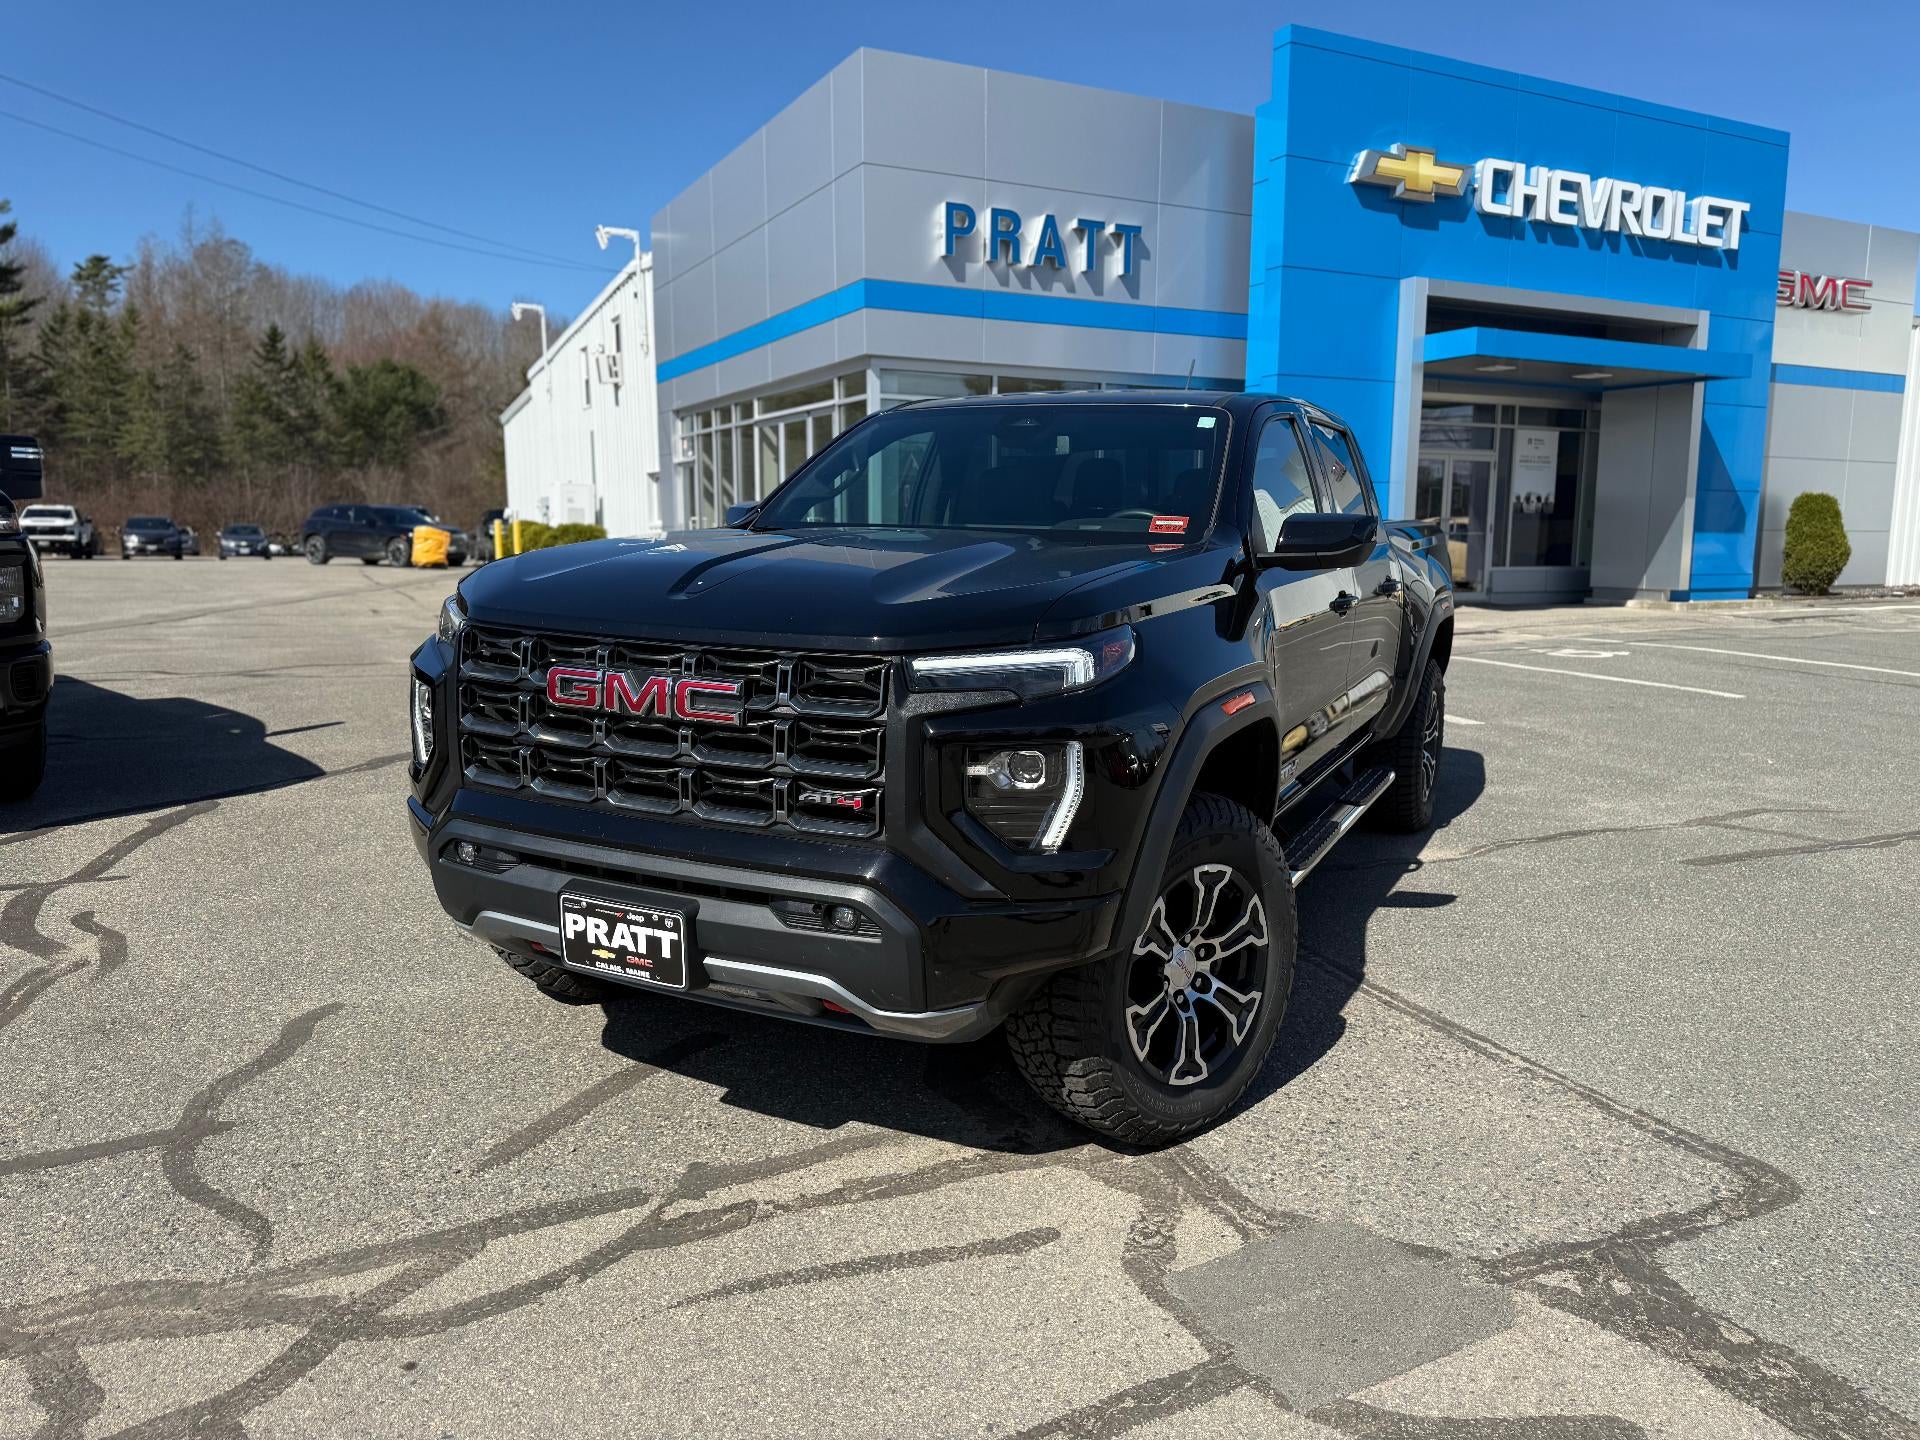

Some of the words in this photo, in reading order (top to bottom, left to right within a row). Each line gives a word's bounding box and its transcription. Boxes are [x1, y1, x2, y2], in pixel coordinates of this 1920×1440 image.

[1477, 157, 1750, 250] CHEVROLET
[942, 201, 1142, 277] PRATT
[546, 666, 744, 724] GMC
[798, 791, 863, 811] AT4
[564, 911, 679, 959] PRATT
[626, 911, 645, 924] Jeep
[626, 955, 654, 968] GMC
